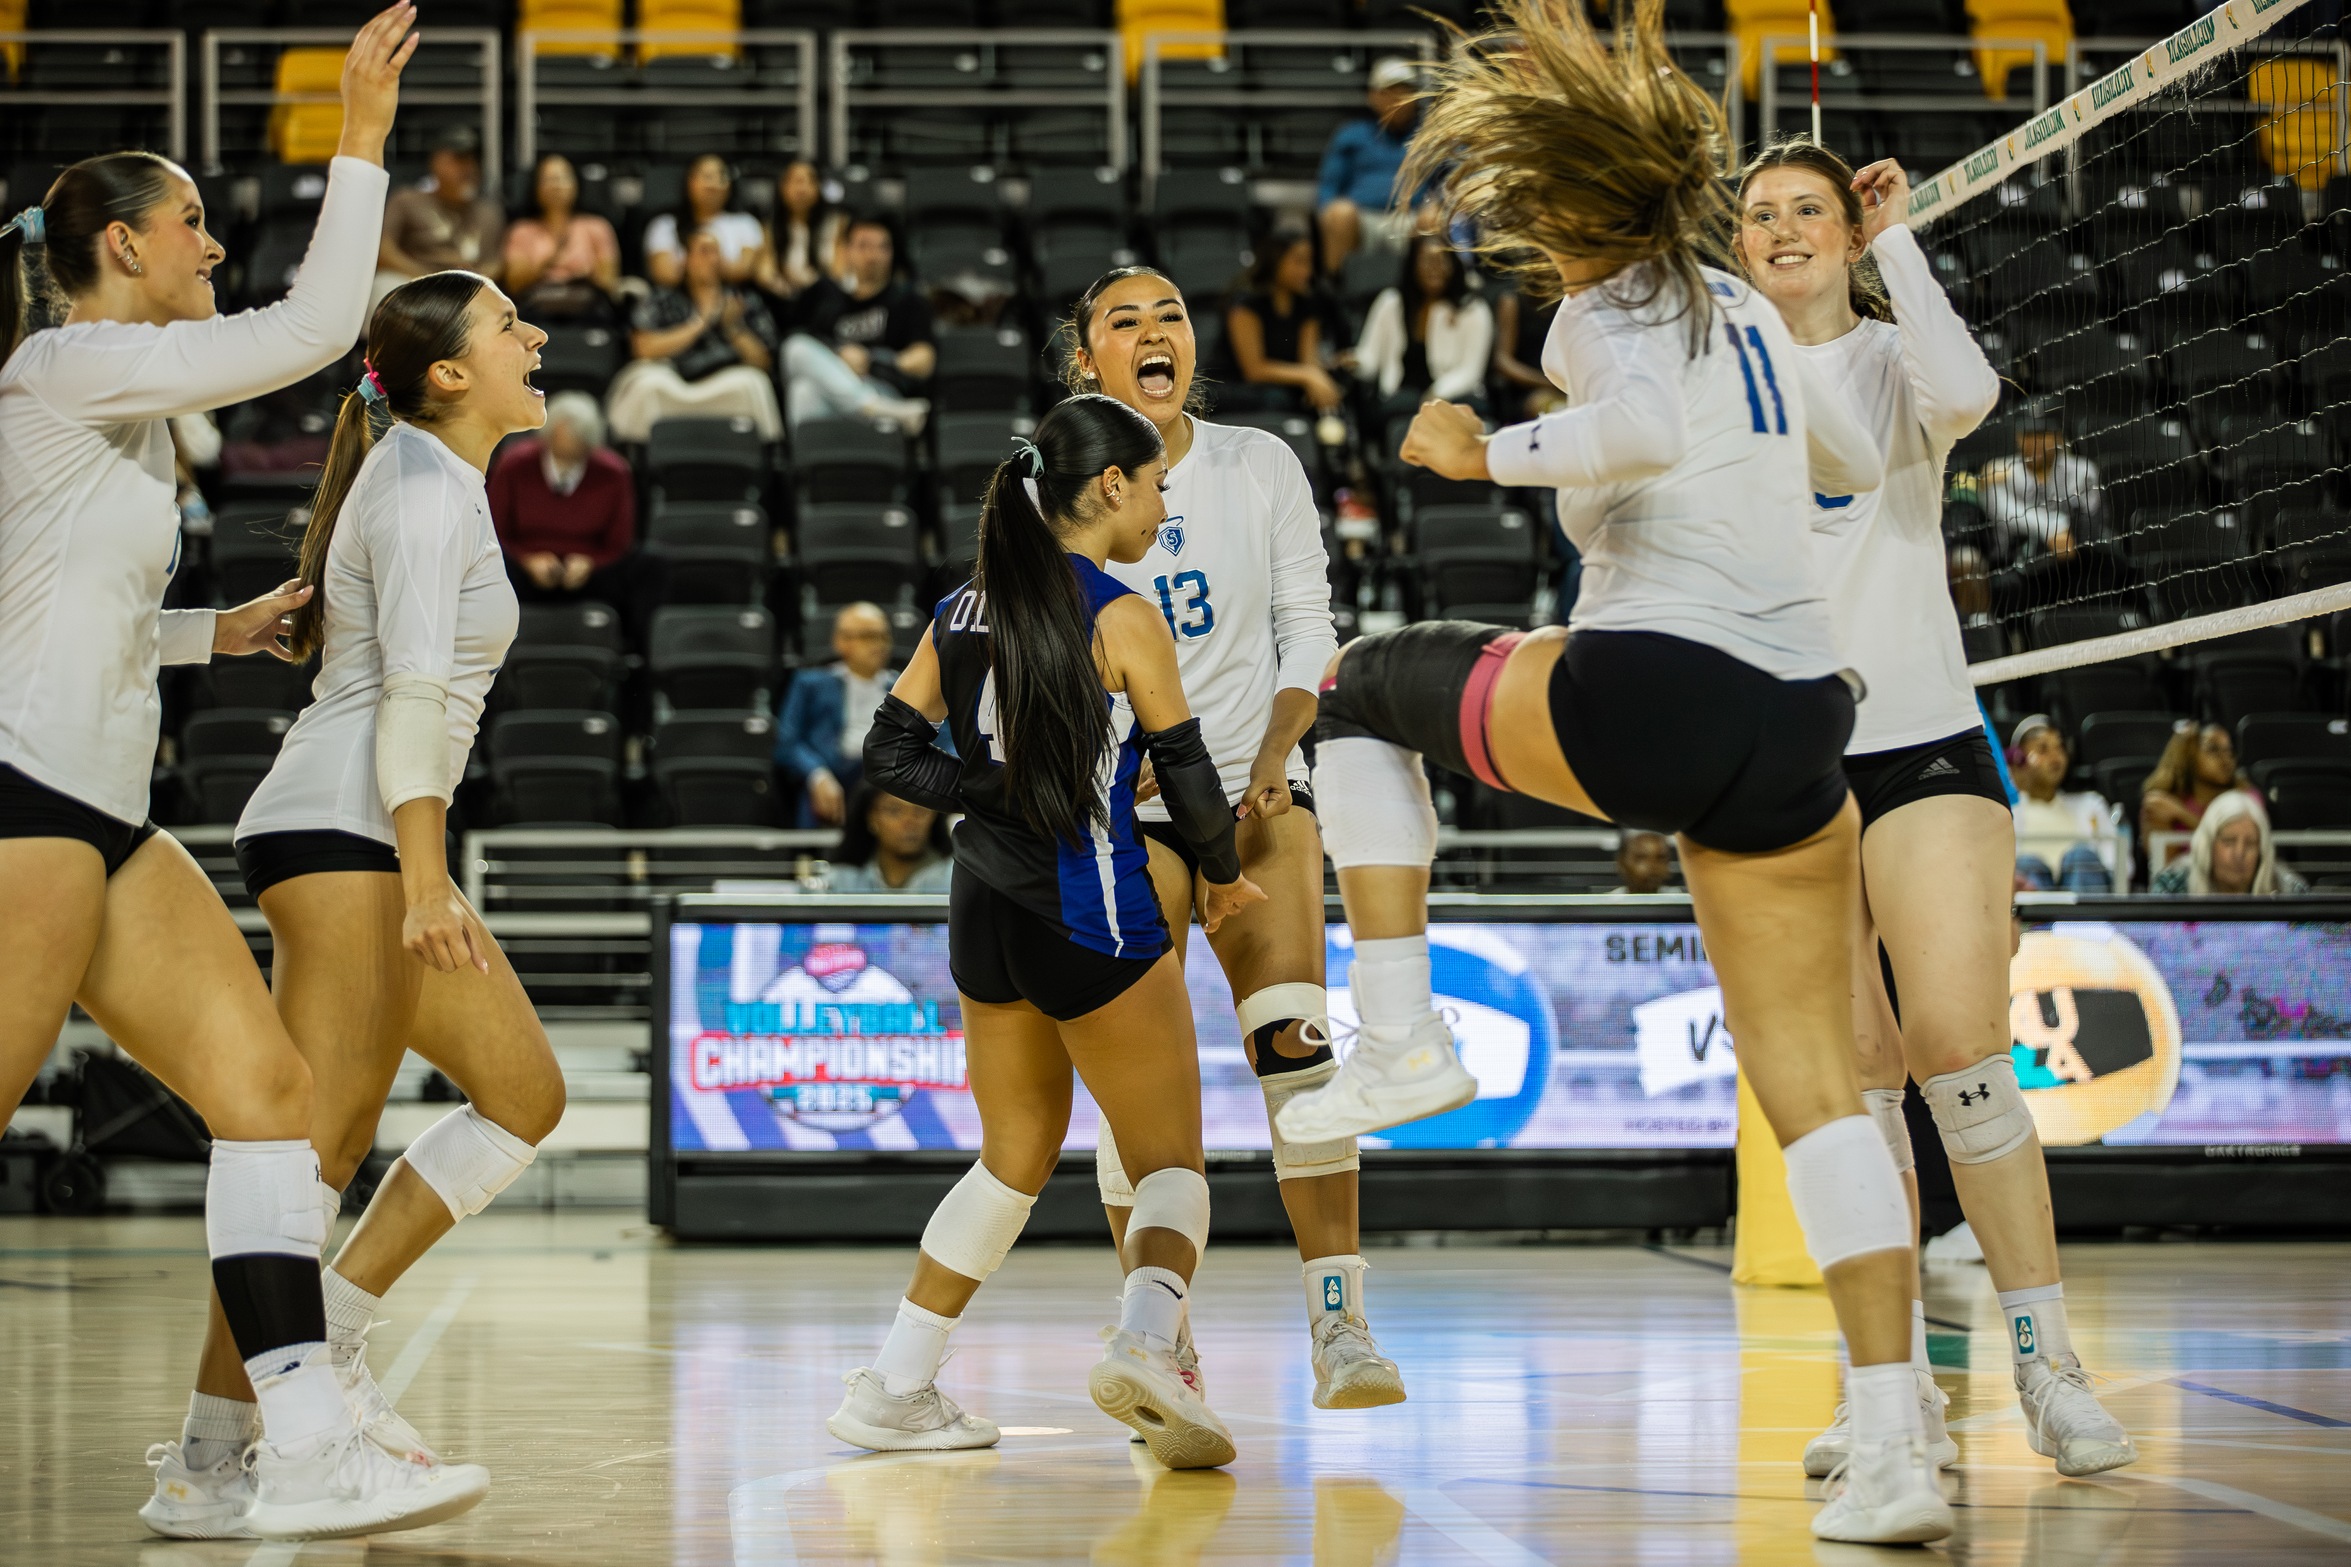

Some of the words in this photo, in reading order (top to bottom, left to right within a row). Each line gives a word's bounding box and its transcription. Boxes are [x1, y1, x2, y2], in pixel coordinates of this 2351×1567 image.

[1725, 323, 1788, 436] 11
[1151, 568, 1215, 642] 13
[1605, 934, 1707, 963] SEMI
[725, 999, 948, 1035] VOLLEYBALL
